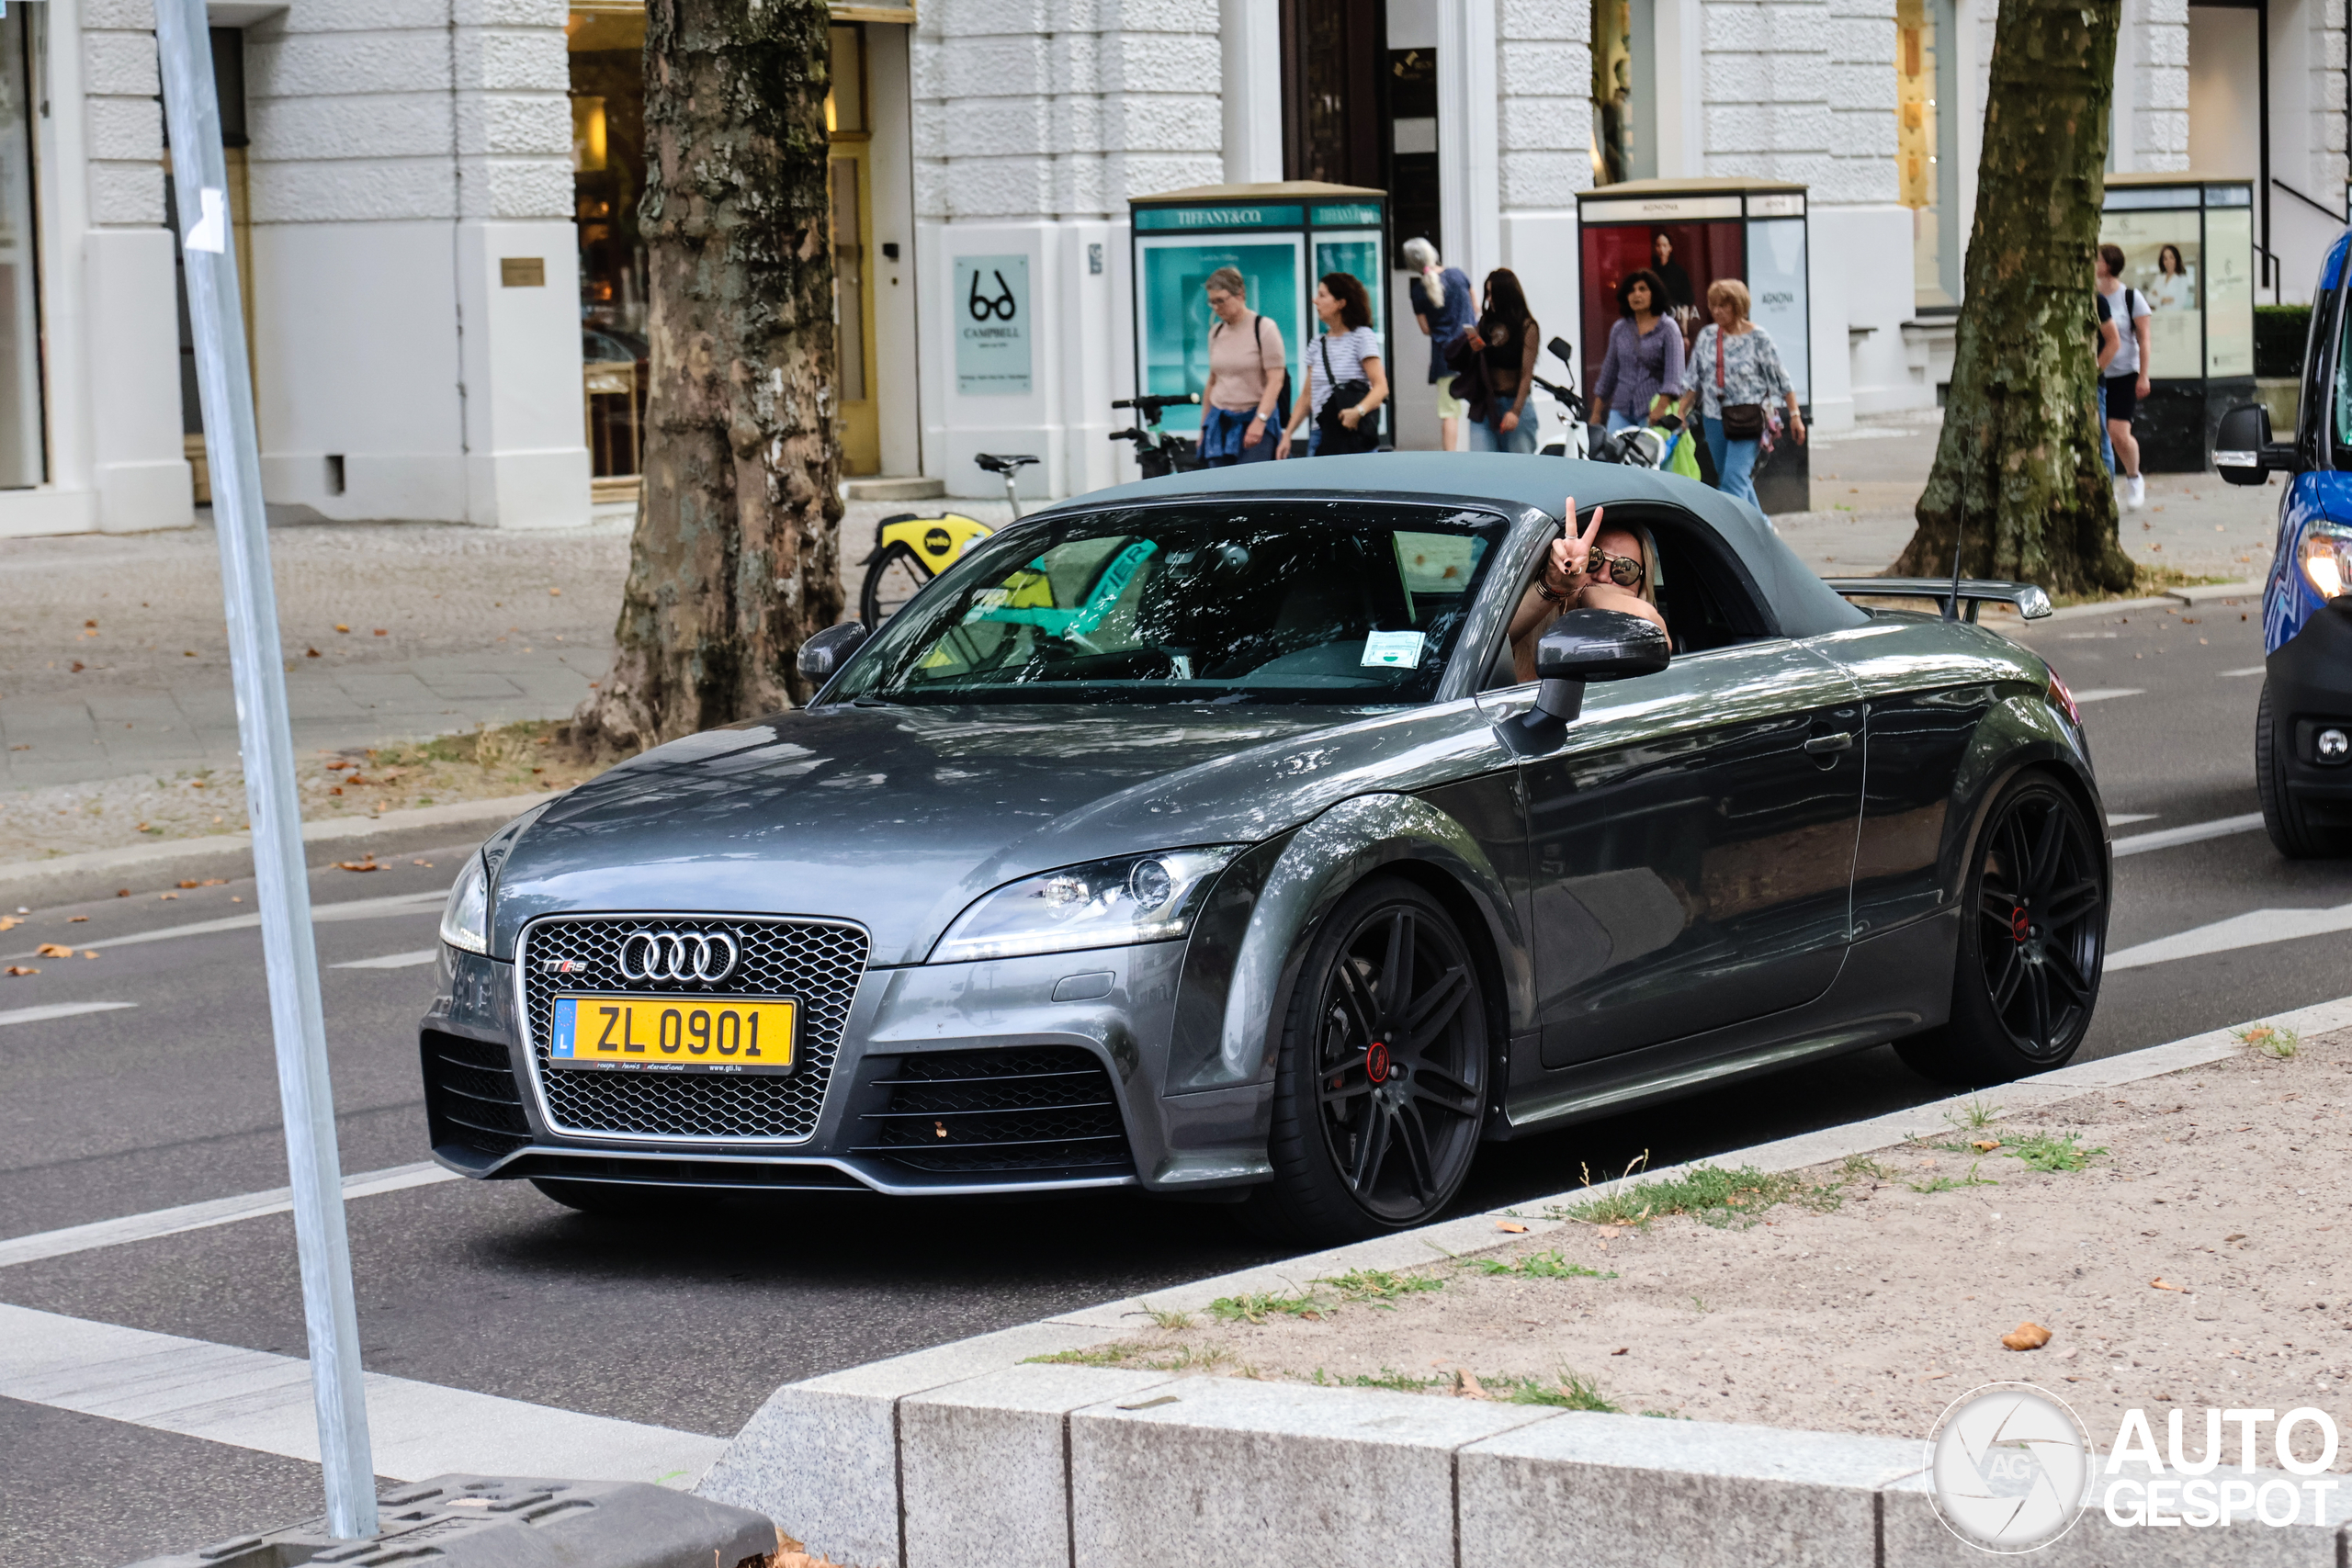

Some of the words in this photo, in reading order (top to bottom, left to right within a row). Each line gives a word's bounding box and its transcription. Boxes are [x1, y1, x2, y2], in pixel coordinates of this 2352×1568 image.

[964, 327, 1020, 339] CAMPBELL
[597, 1007, 645, 1053] ZL
[660, 1009, 762, 1056] 0901
[560, 1033, 568, 1050] L
[641, 1063, 685, 1072] International
[708, 1064, 742, 1072] www.gti.lu
